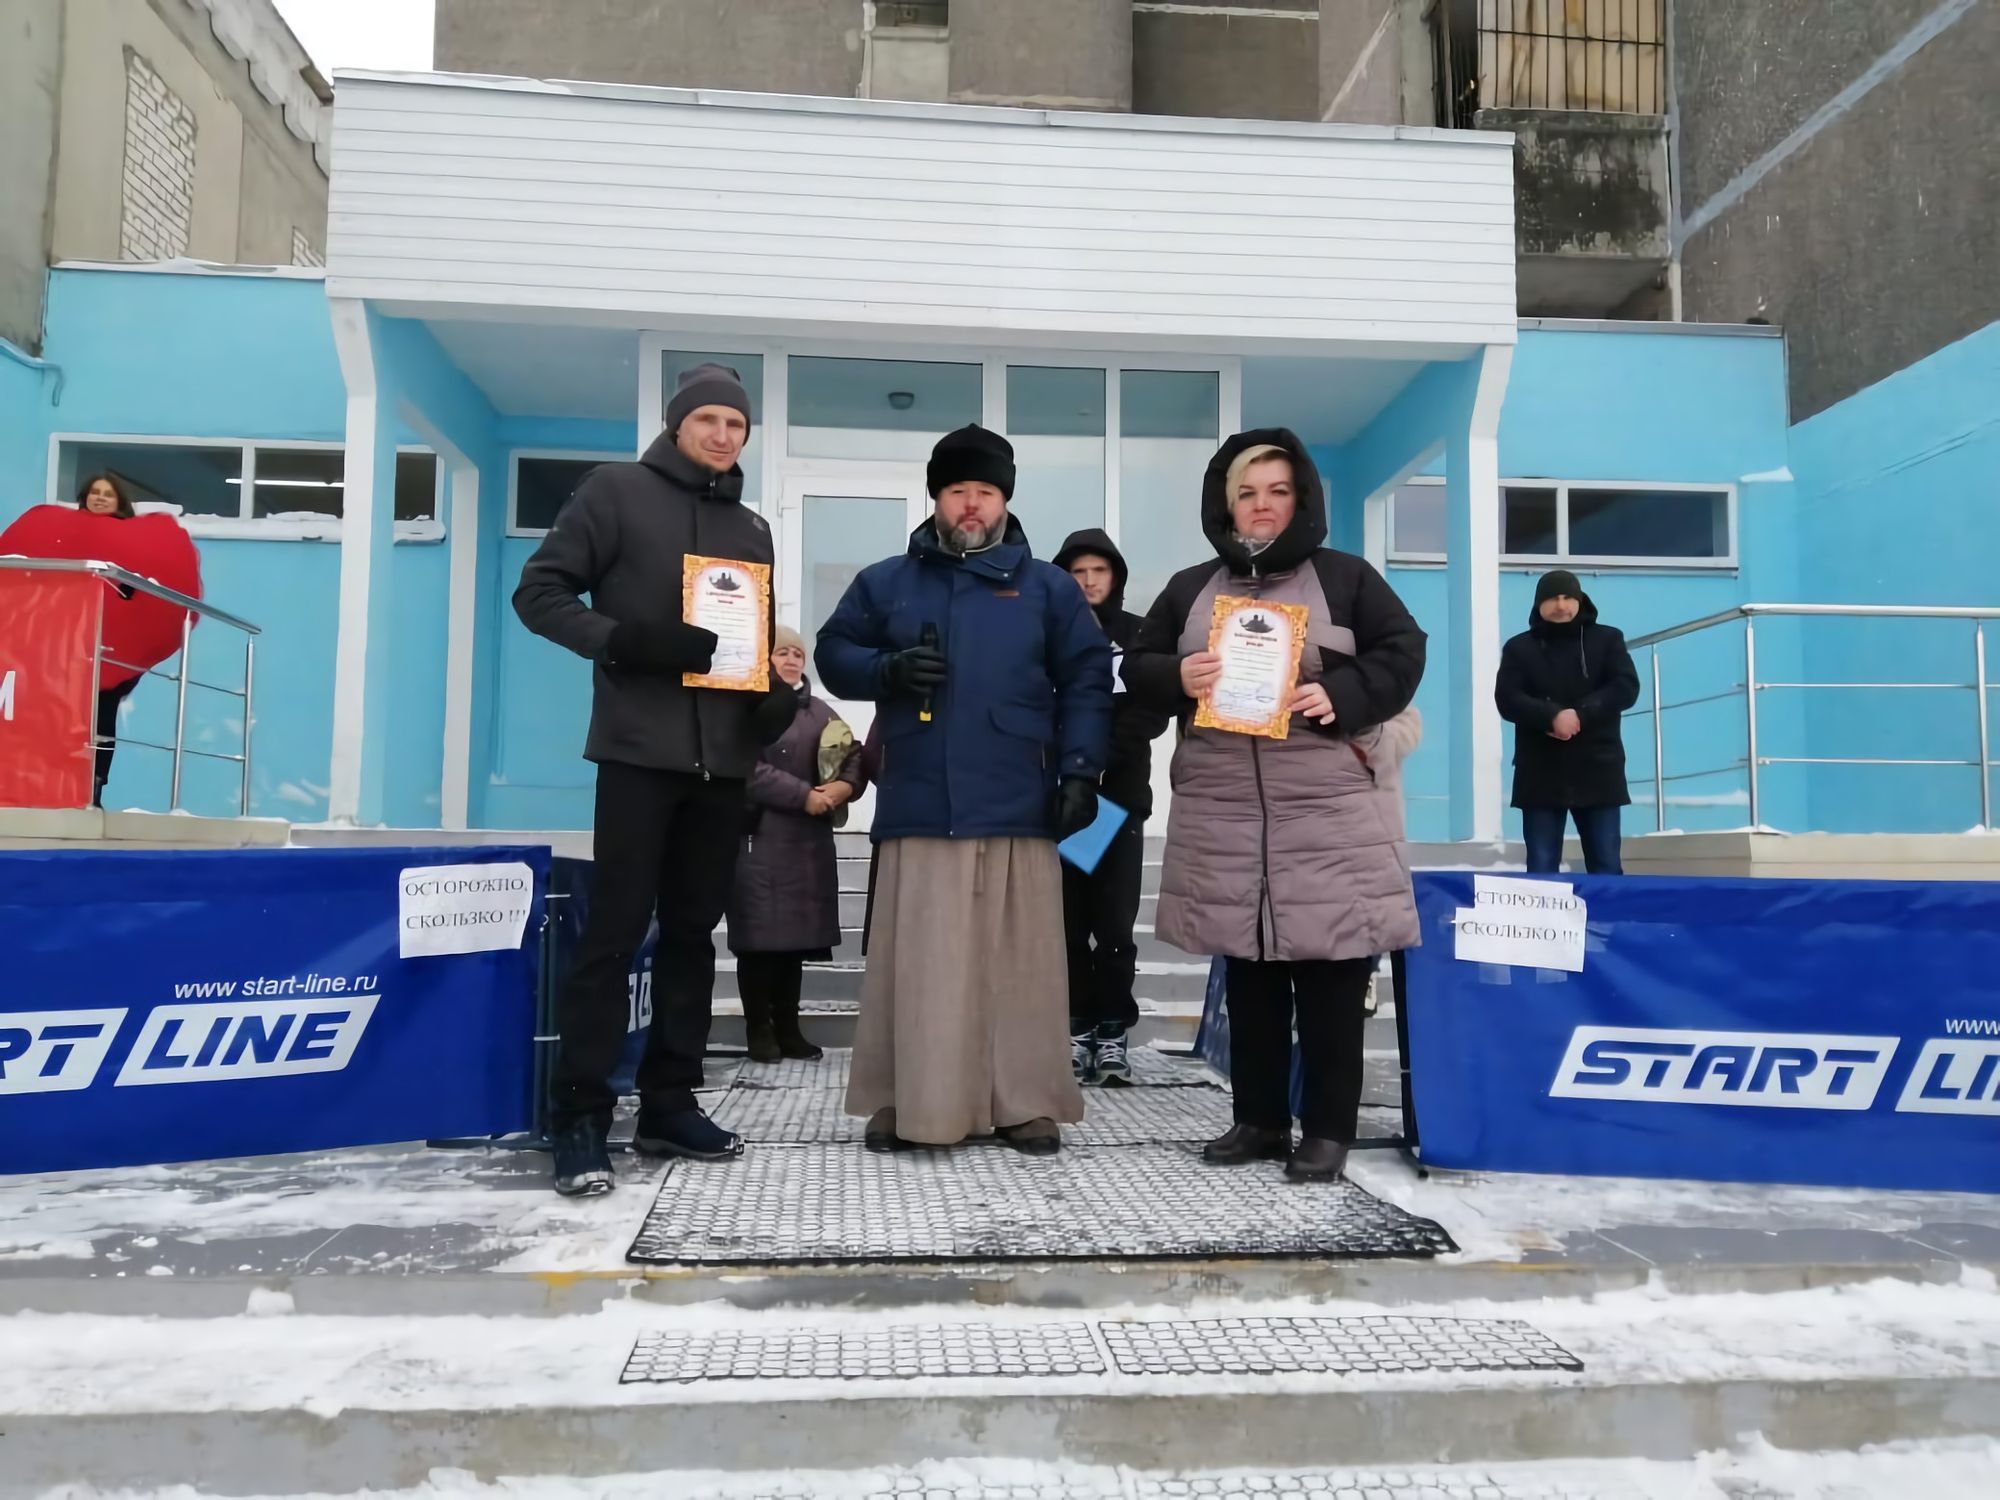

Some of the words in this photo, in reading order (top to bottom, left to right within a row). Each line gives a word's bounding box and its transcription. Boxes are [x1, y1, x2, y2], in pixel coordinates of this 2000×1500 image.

[406, 910, 503, 929] СКОЛЬЗКО
[142, 1010, 352, 1069] LINE
[1573, 1040, 1880, 1095] START
[1919, 1053, 2000, 1101] LI
